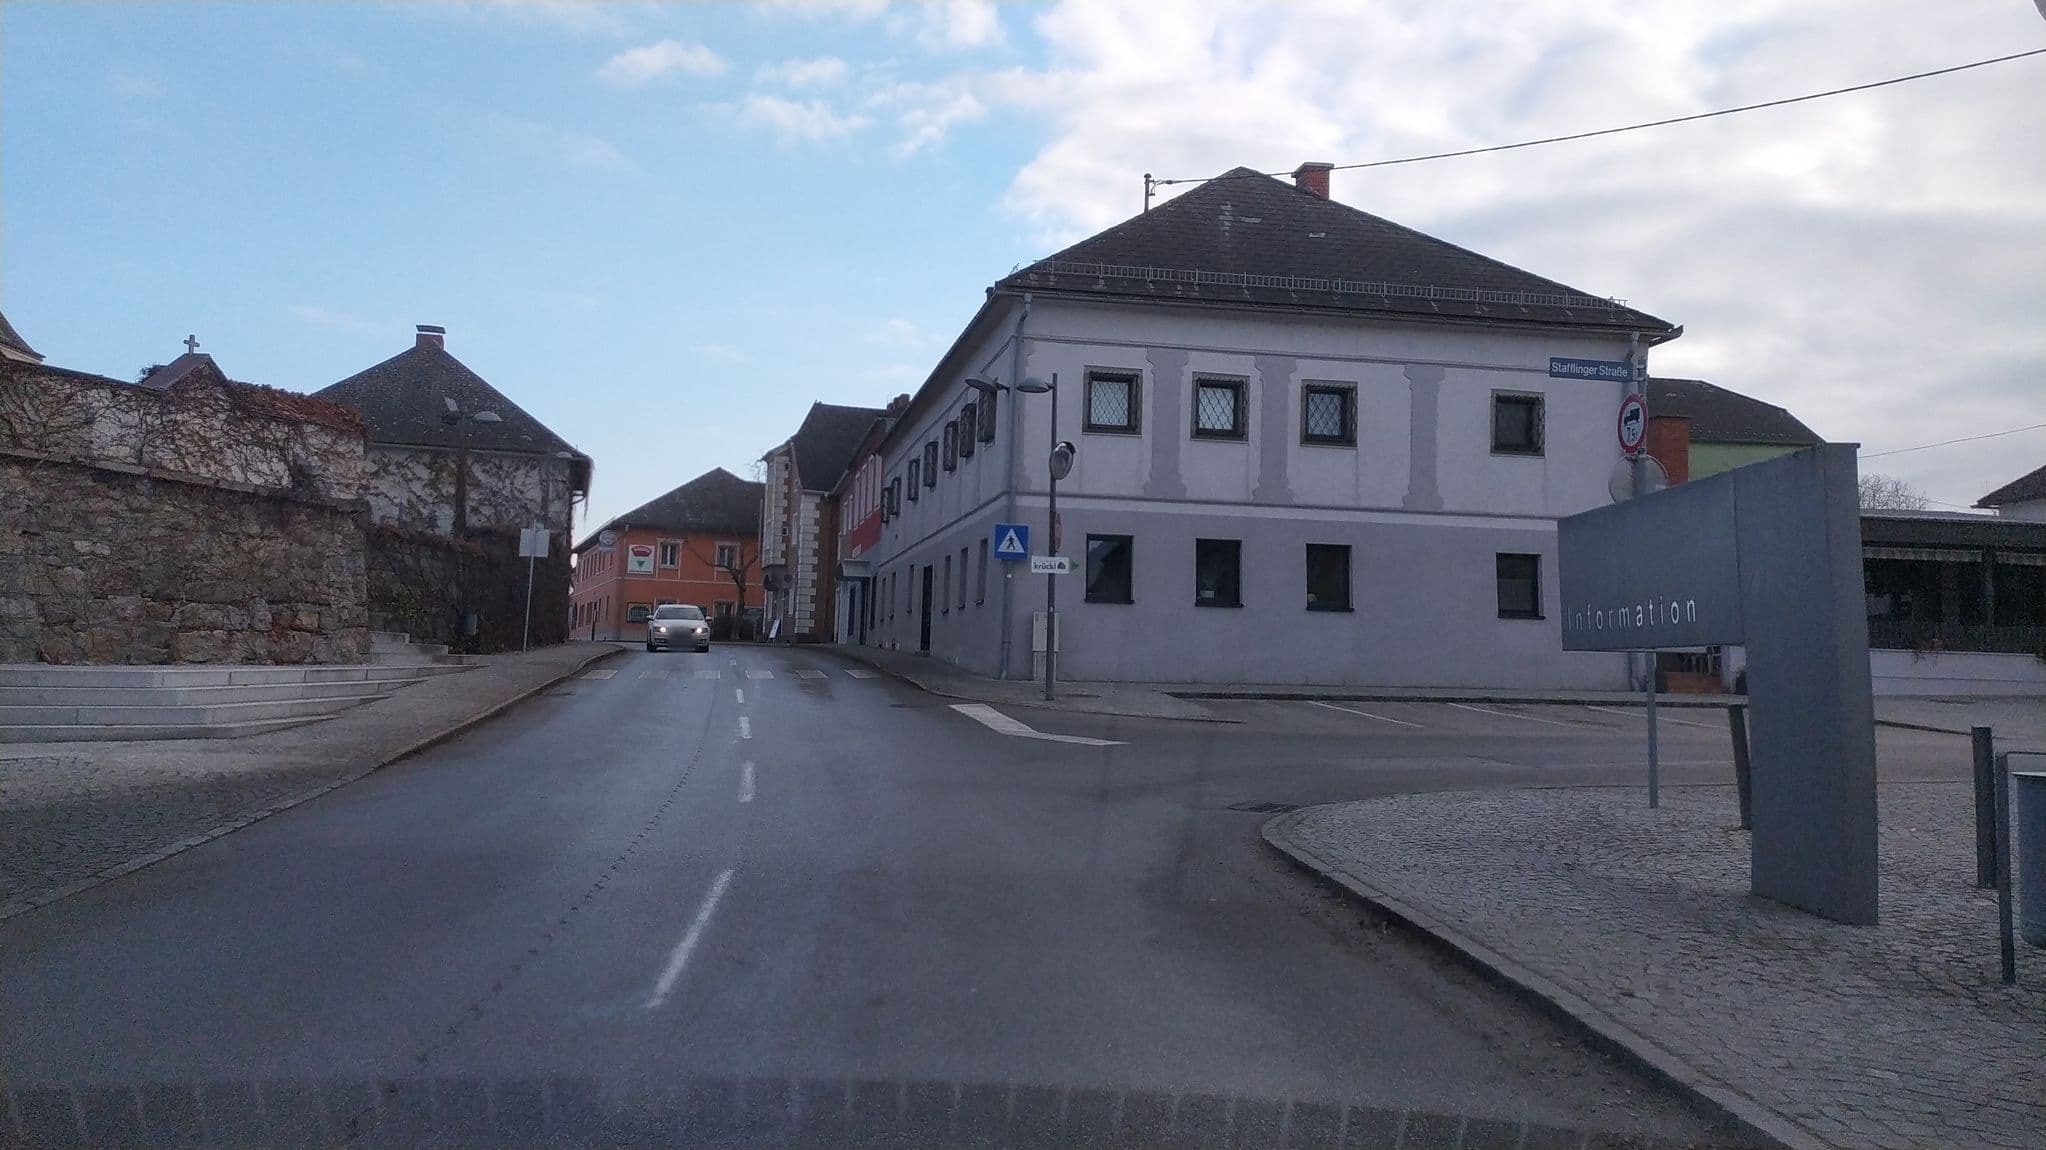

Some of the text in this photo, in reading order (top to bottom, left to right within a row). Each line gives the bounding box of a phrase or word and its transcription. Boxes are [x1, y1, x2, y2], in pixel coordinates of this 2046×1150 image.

[1551, 361, 1628, 378] Stafflinger Straße
[1567, 595, 1697, 630] Information
